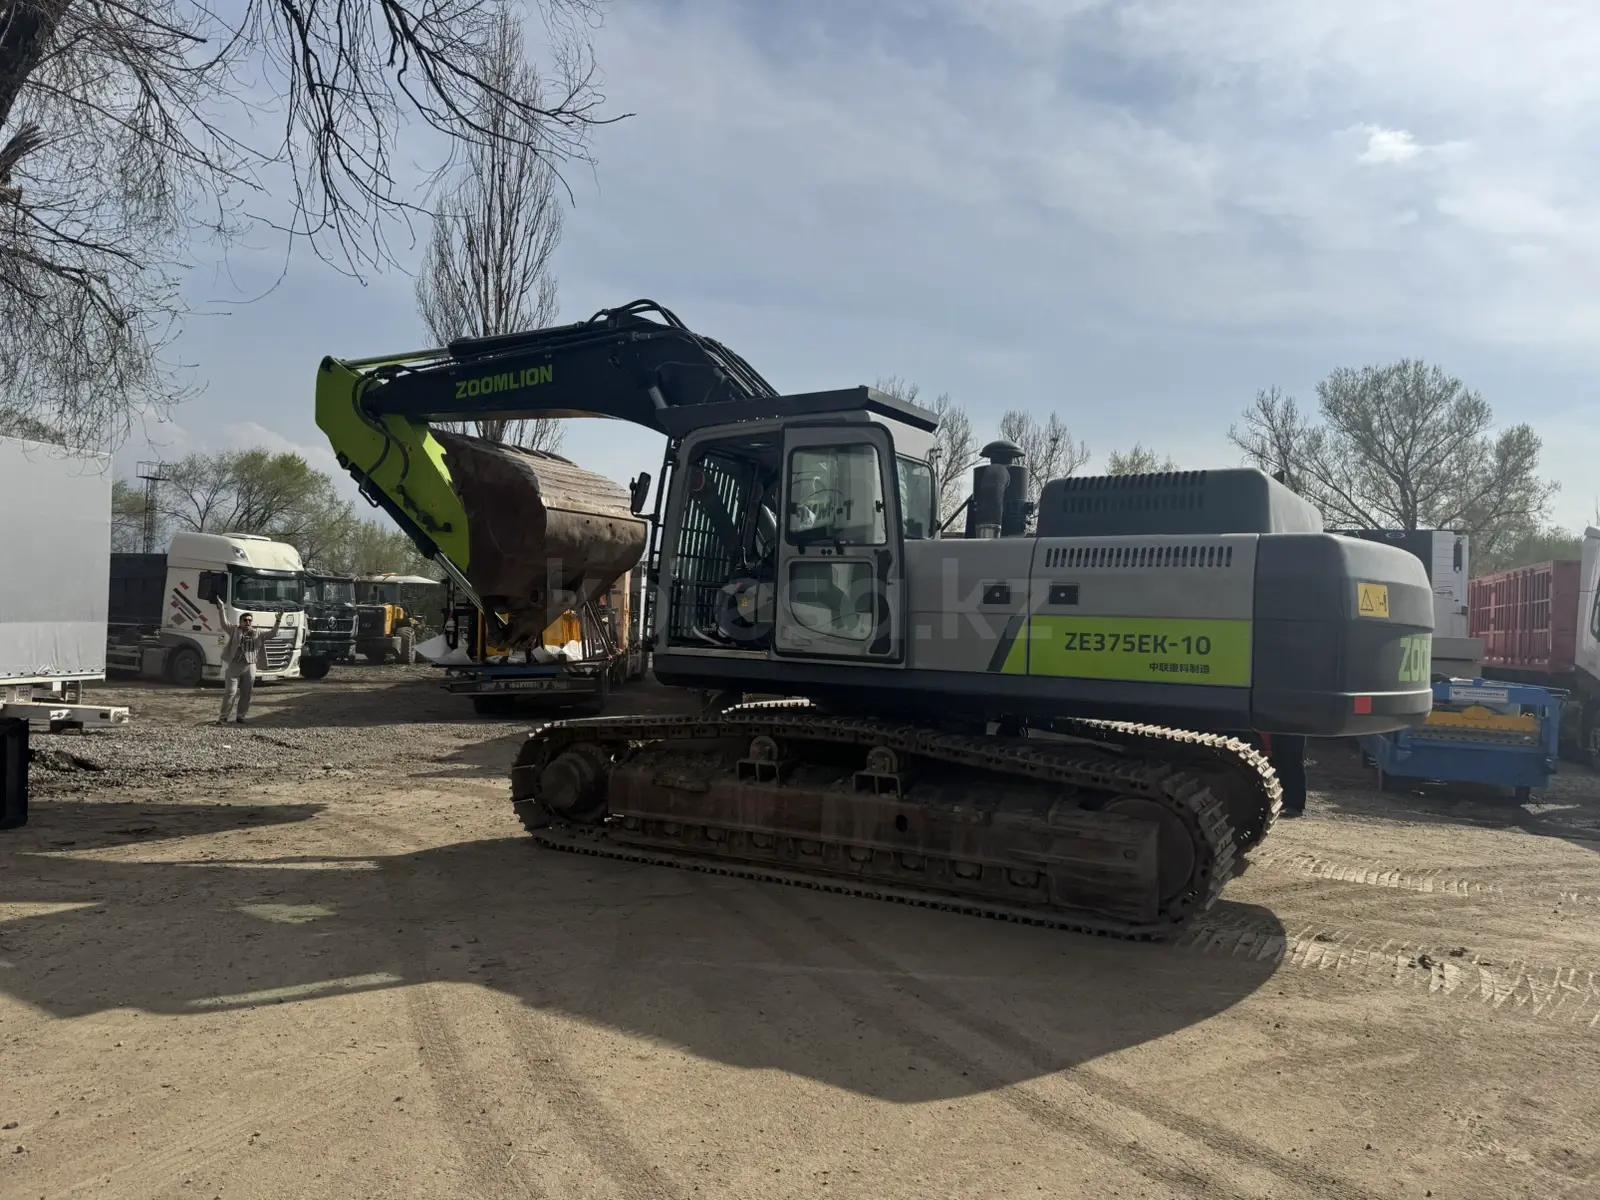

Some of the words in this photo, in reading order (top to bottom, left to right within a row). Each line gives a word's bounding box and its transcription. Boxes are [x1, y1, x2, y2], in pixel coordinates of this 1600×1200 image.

[455, 364, 553, 399] ZOOMLION
[1065, 632, 1212, 655] ZE375EK-10
[1399, 636, 1431, 682] ZOO
